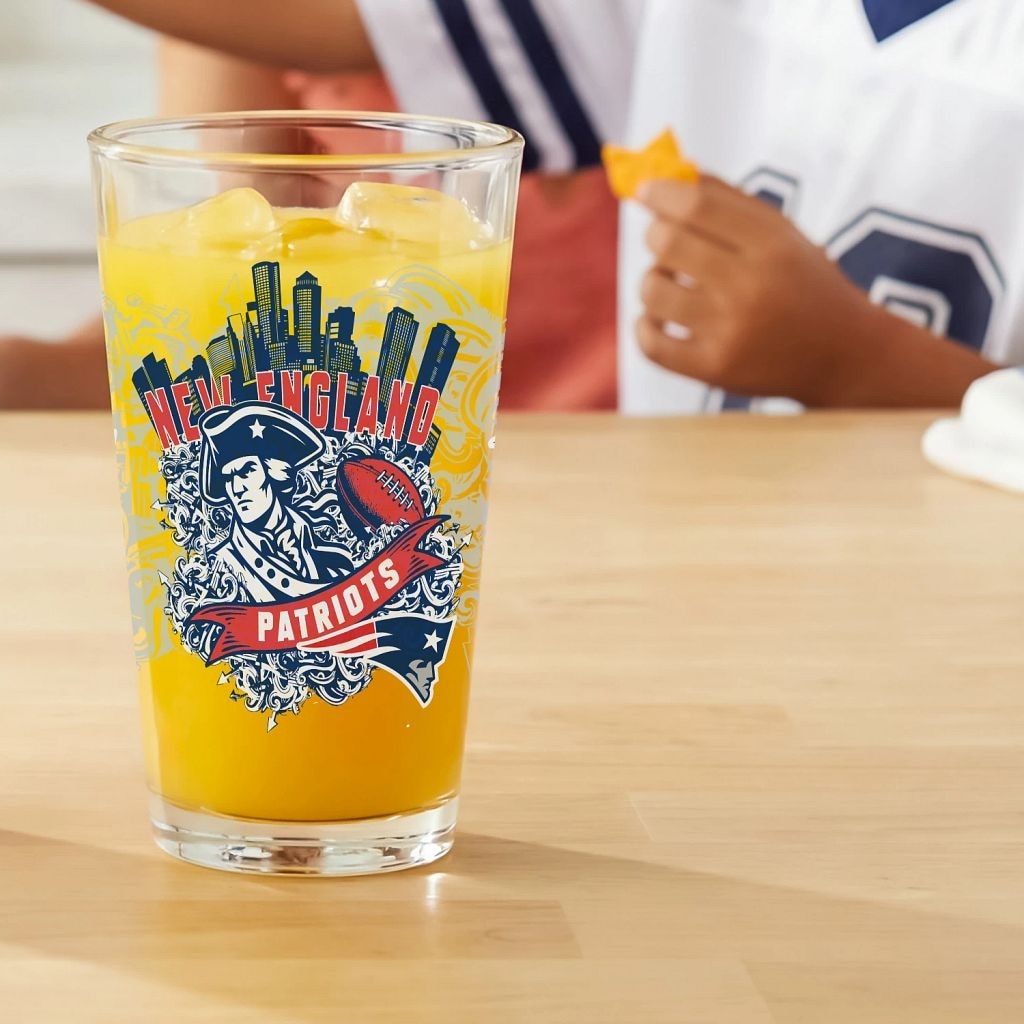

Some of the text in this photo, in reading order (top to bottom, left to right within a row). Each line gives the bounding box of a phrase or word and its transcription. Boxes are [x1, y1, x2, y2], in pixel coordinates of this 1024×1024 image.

[144, 370, 441, 450] NEW ENGLAND
[257, 558, 400, 642] PATRIOTS
